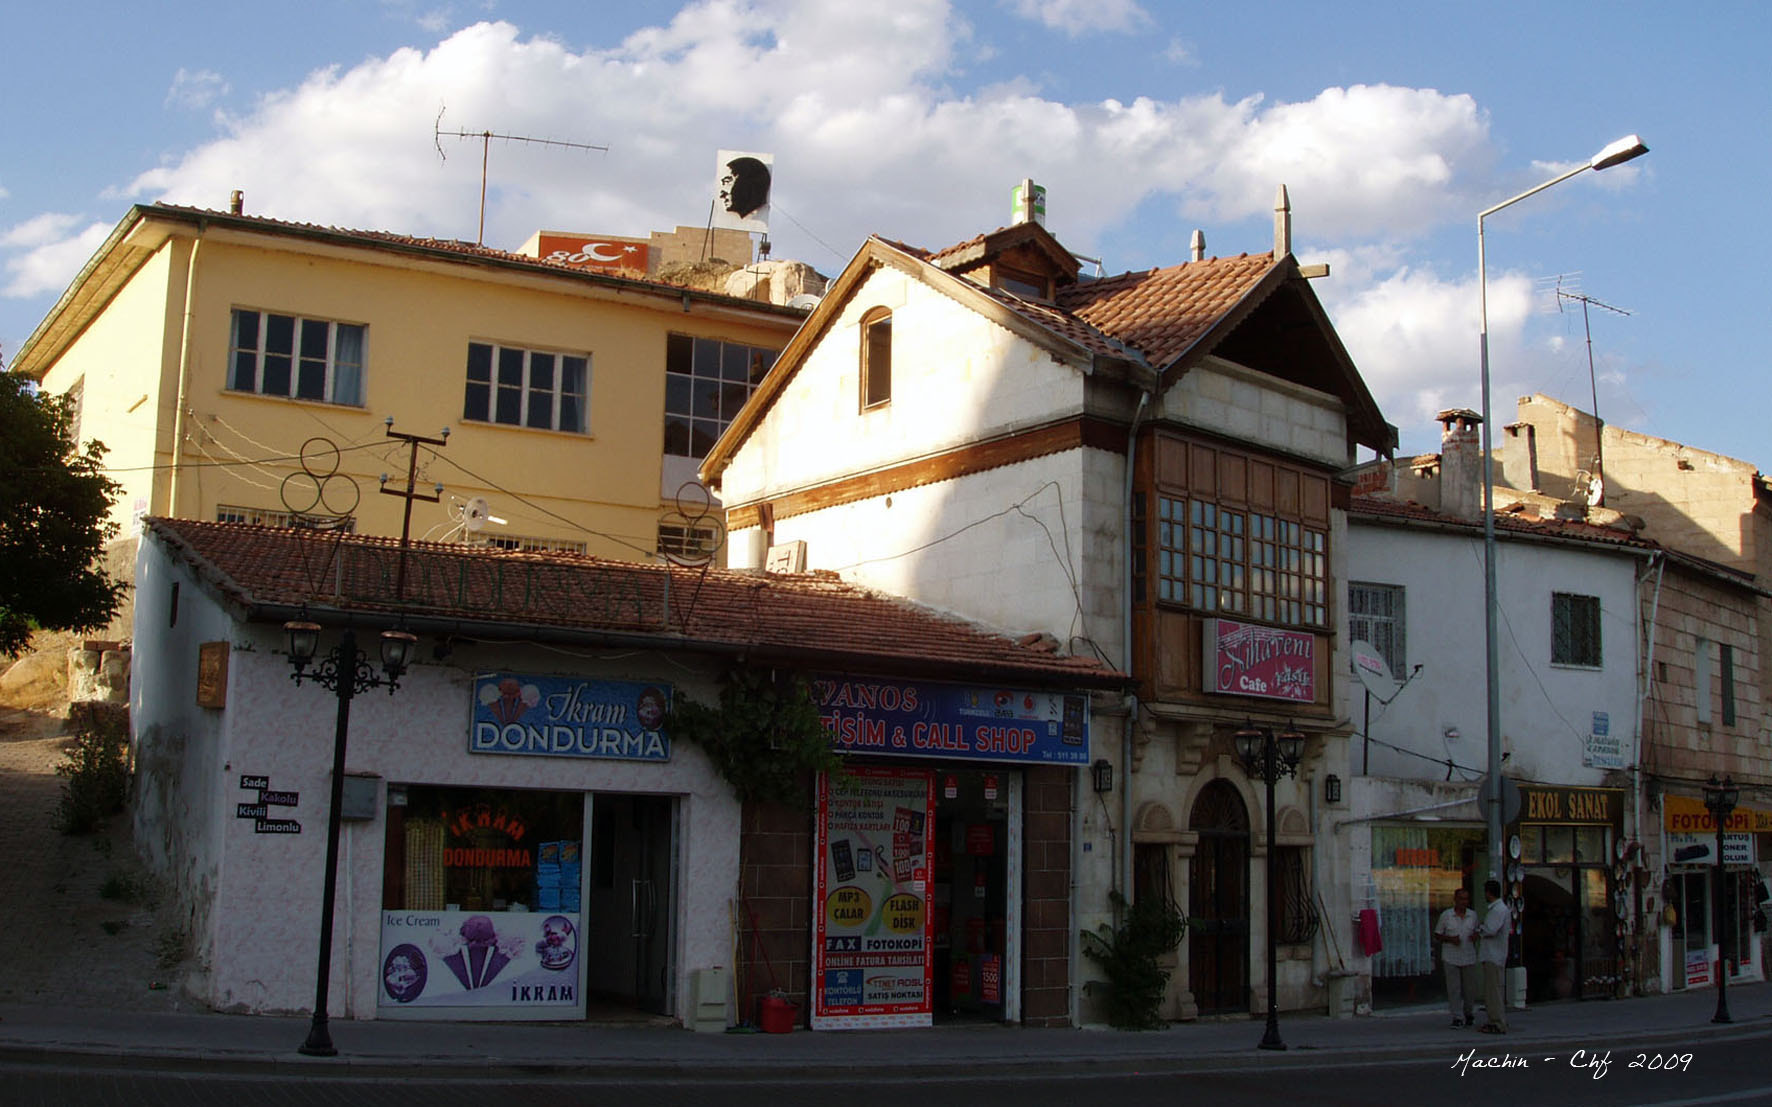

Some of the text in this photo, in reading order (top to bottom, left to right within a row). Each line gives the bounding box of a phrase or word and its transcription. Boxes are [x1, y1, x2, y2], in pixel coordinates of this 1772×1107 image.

[1240, 675, 1267, 693] Cafe
[818, 709, 1036, 754] TİŞİM & CALL SHOP
[476, 721, 666, 757] DONDURMA
[241, 777, 268, 788] Sade
[1528, 791, 1608, 819] EKOL SANAT
[257, 820, 300, 832] Limonlu
[443, 849, 531, 868] DONDURMA
[838, 892, 859, 902] MP3
[890, 900, 919, 911] FLASH
[387, 914, 440, 926] Ice Cream
[826, 936, 922, 951] FAX FOTOKOPİ
[856, 954, 885, 966] FATURA
[512, 981, 573, 1001] İKRAM
[891, 990, 923, 999] NOKTASI
